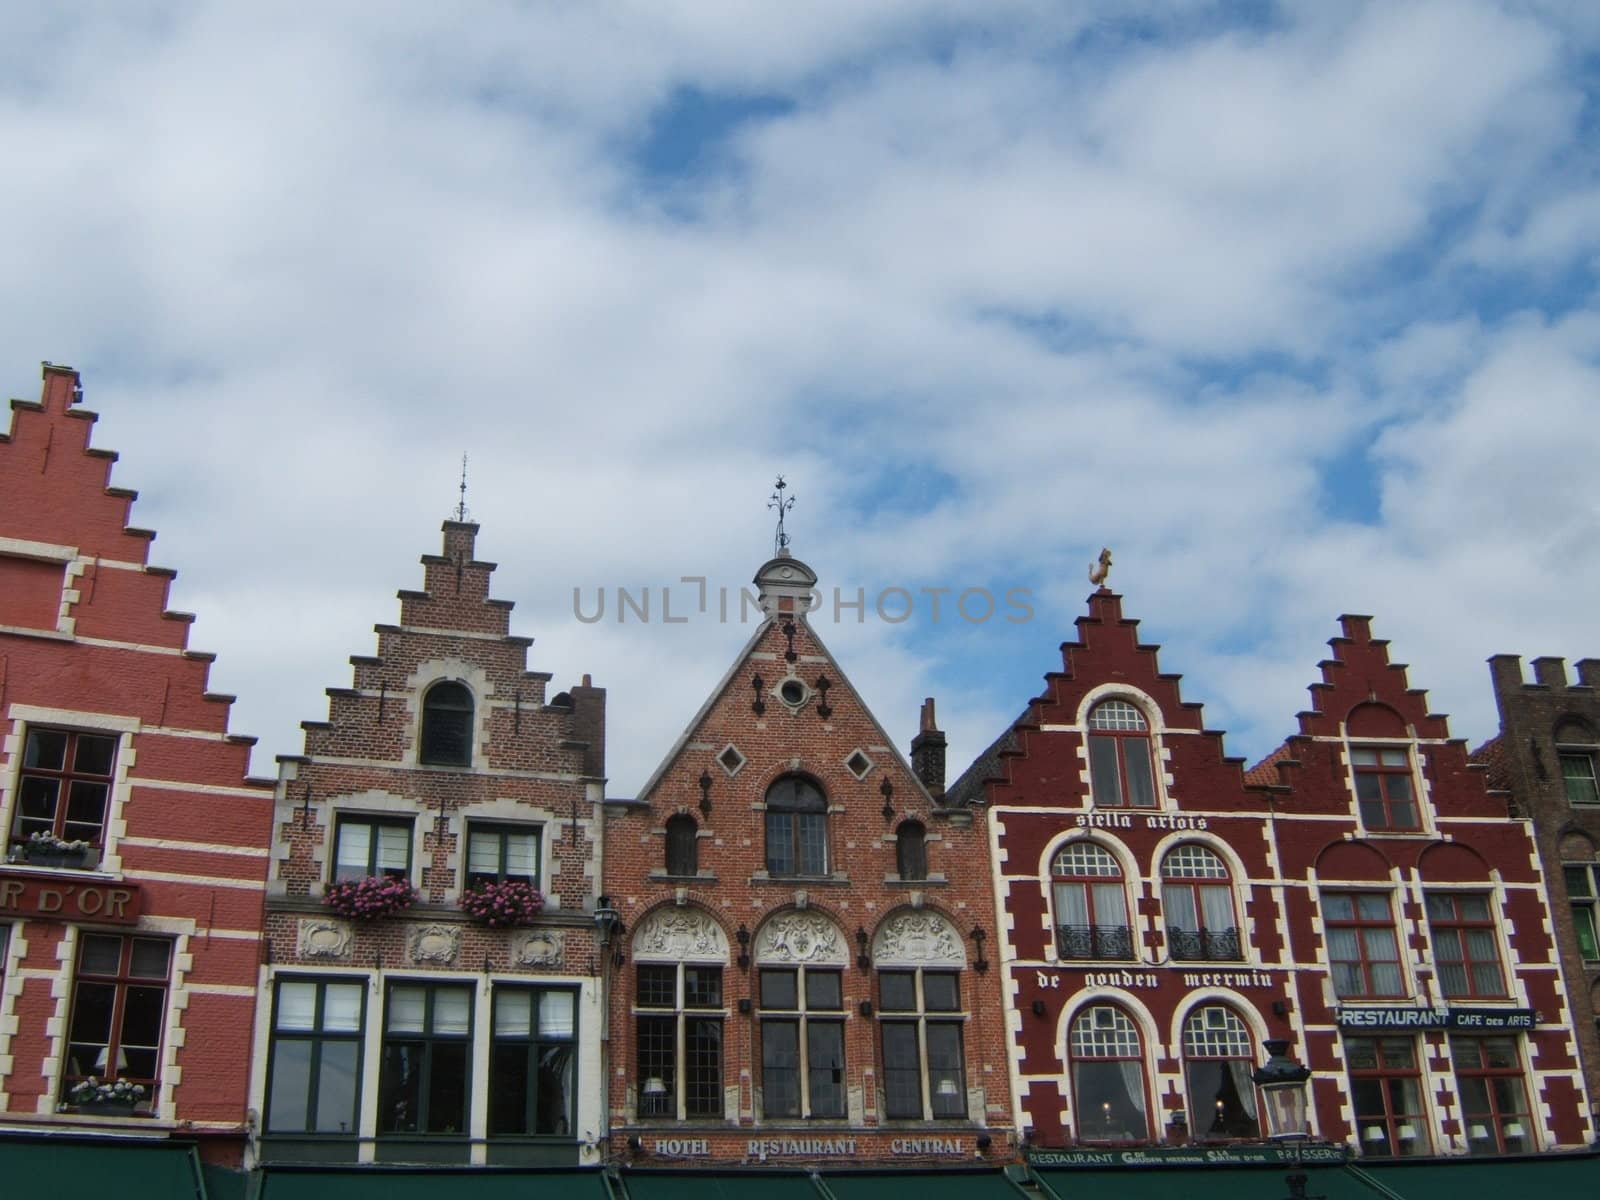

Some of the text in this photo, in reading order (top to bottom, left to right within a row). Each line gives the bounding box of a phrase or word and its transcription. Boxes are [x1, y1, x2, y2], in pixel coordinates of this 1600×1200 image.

[1076, 812, 1208, 830] stella artois
[38, 885, 131, 917] D'OR
[1036, 970, 1273, 988] de gouden meermin
[1341, 1010, 1447, 1025] RESTAURANT
[1507, 1015, 1531, 1026] ARTS
[655, 1139, 965, 1154] HOTEL RESTAURANT CENTRAL
[1029, 1153, 1113, 1164] RESTAURANT
